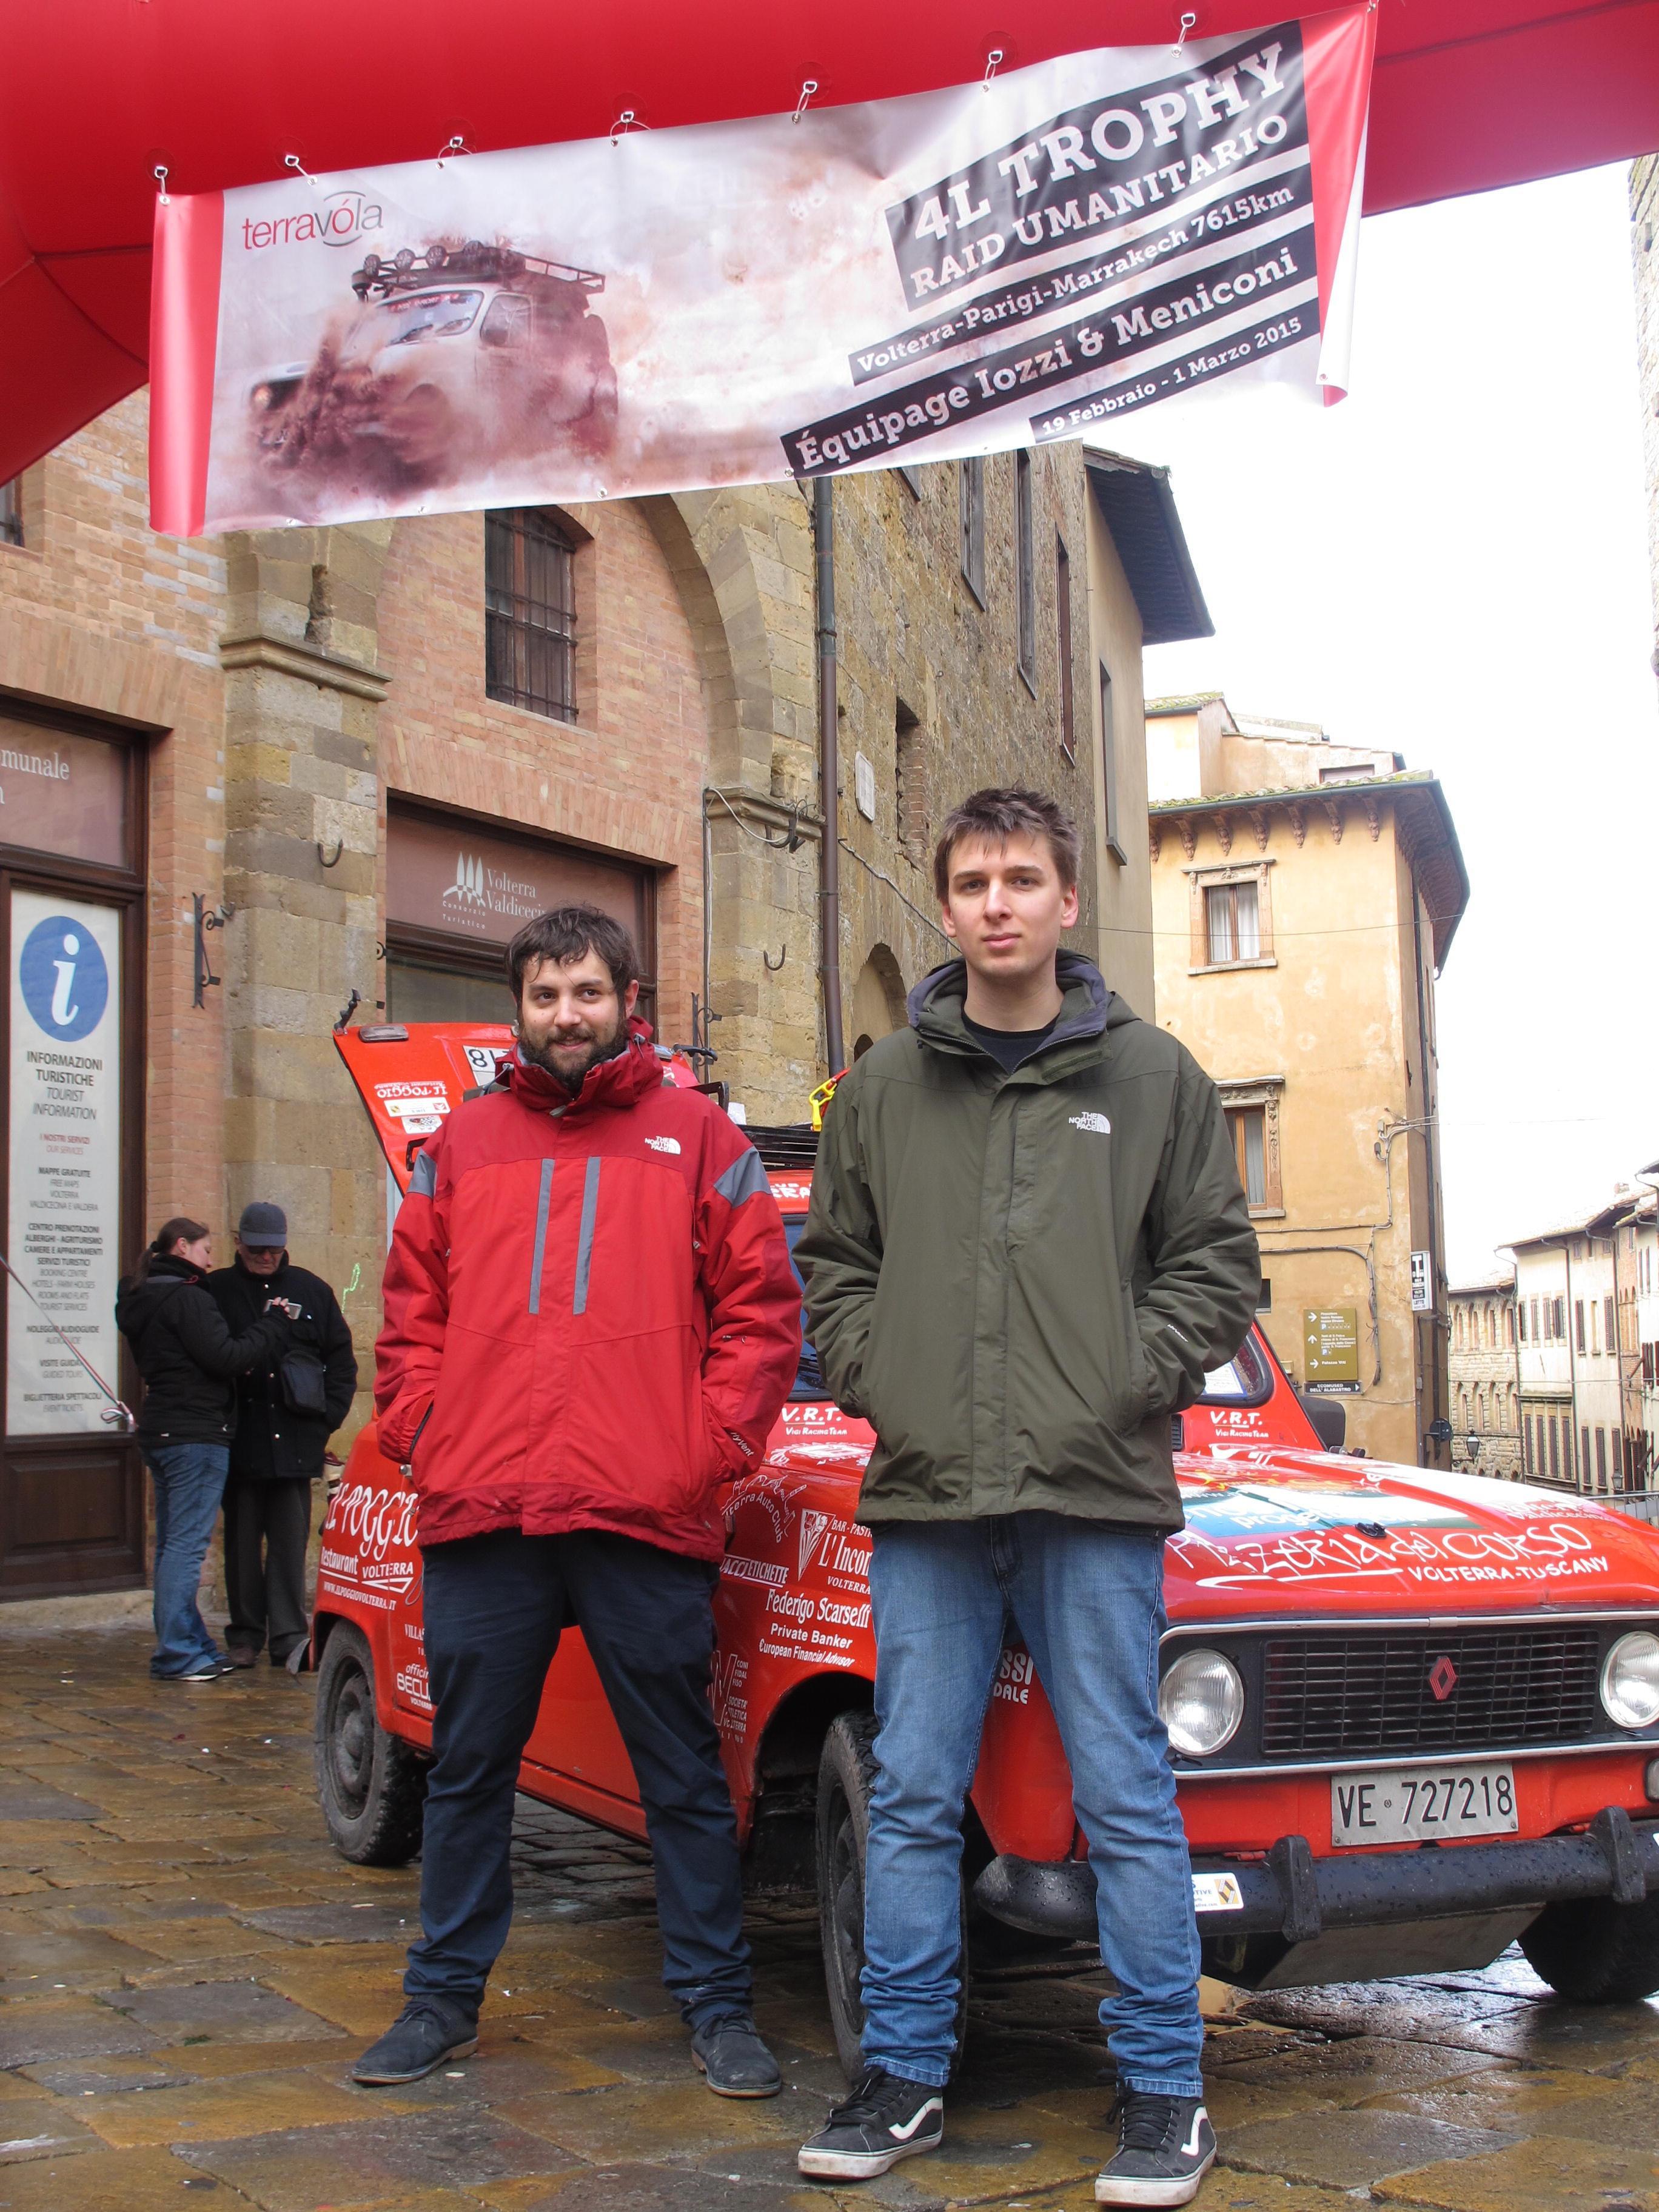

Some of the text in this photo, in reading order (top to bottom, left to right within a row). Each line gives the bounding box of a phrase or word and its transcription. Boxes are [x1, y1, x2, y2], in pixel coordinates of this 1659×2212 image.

[913, 41, 1289, 244] 4L TROPHY
[910, 114, 1289, 299] RAID UMANITARIO
[242, 198, 384, 250] terravóla
[857, 184, 1295, 372] Volterra-Parigi-Marrakech 7615km
[796, 247, 1298, 471] Équipage Iozzi & Meniconi
[1041, 417, 1066, 435] 19
[1068, 380, 1158, 424] Febbraio
[1173, 367, 1184, 384] 1
[1187, 340, 1251, 377] Marzo
[1254, 317, 1302, 351] 2015
[486, 868, 537, 899] Volterra
[27, 1051, 103, 1071] INFORMAZIONI
[36, 1069, 94, 1086] TURISTICHE
[46, 1087, 84, 1102] TOURIST
[33, 1103, 97, 1121] INFORMATION
[1068, 1117, 1097, 1126] NORTH
[1081, 1111, 1099, 1120] THE
[1076, 1123, 1098, 1131] FACE
[43, 1134, 66, 1143] NOSTRI
[67, 1136, 90, 1145] SERVIZI
[645, 1138, 669, 1148] NORTH
[651, 1144, 669, 1153] FACE
[38, 1167, 90, 1178] MAPPE GRATUITE
[781, 1407, 842, 1422] V.R.T.
[1210, 1410, 1263, 1426] V.R.T.
[756, 1491, 774, 1513] Auto
[771, 1509, 783, 1543] Club
[831, 1519, 848, 1532] BAR
[850, 1523, 873, 1538] PASTI
[361, 1561, 414, 1579] VOLTERRA
[747, 1560, 789, 1584] ETICHETTE
[827, 1575, 871, 1595] VOLTERRA
[765, 1589, 873, 1629] Federigo Scarselli
[770, 1622, 853, 1649] Private Banker
[736, 1660, 748, 1669] CONI
[793, 1646, 825, 1663] Financial
[823, 1651, 856, 1667] Advisor
[732, 1678, 742, 1687] FISO
[734, 1669, 747, 1679] FIDAL
[397, 1672, 431, 1701] BECU
[1337, 1774, 1513, 1828] VE 727218
